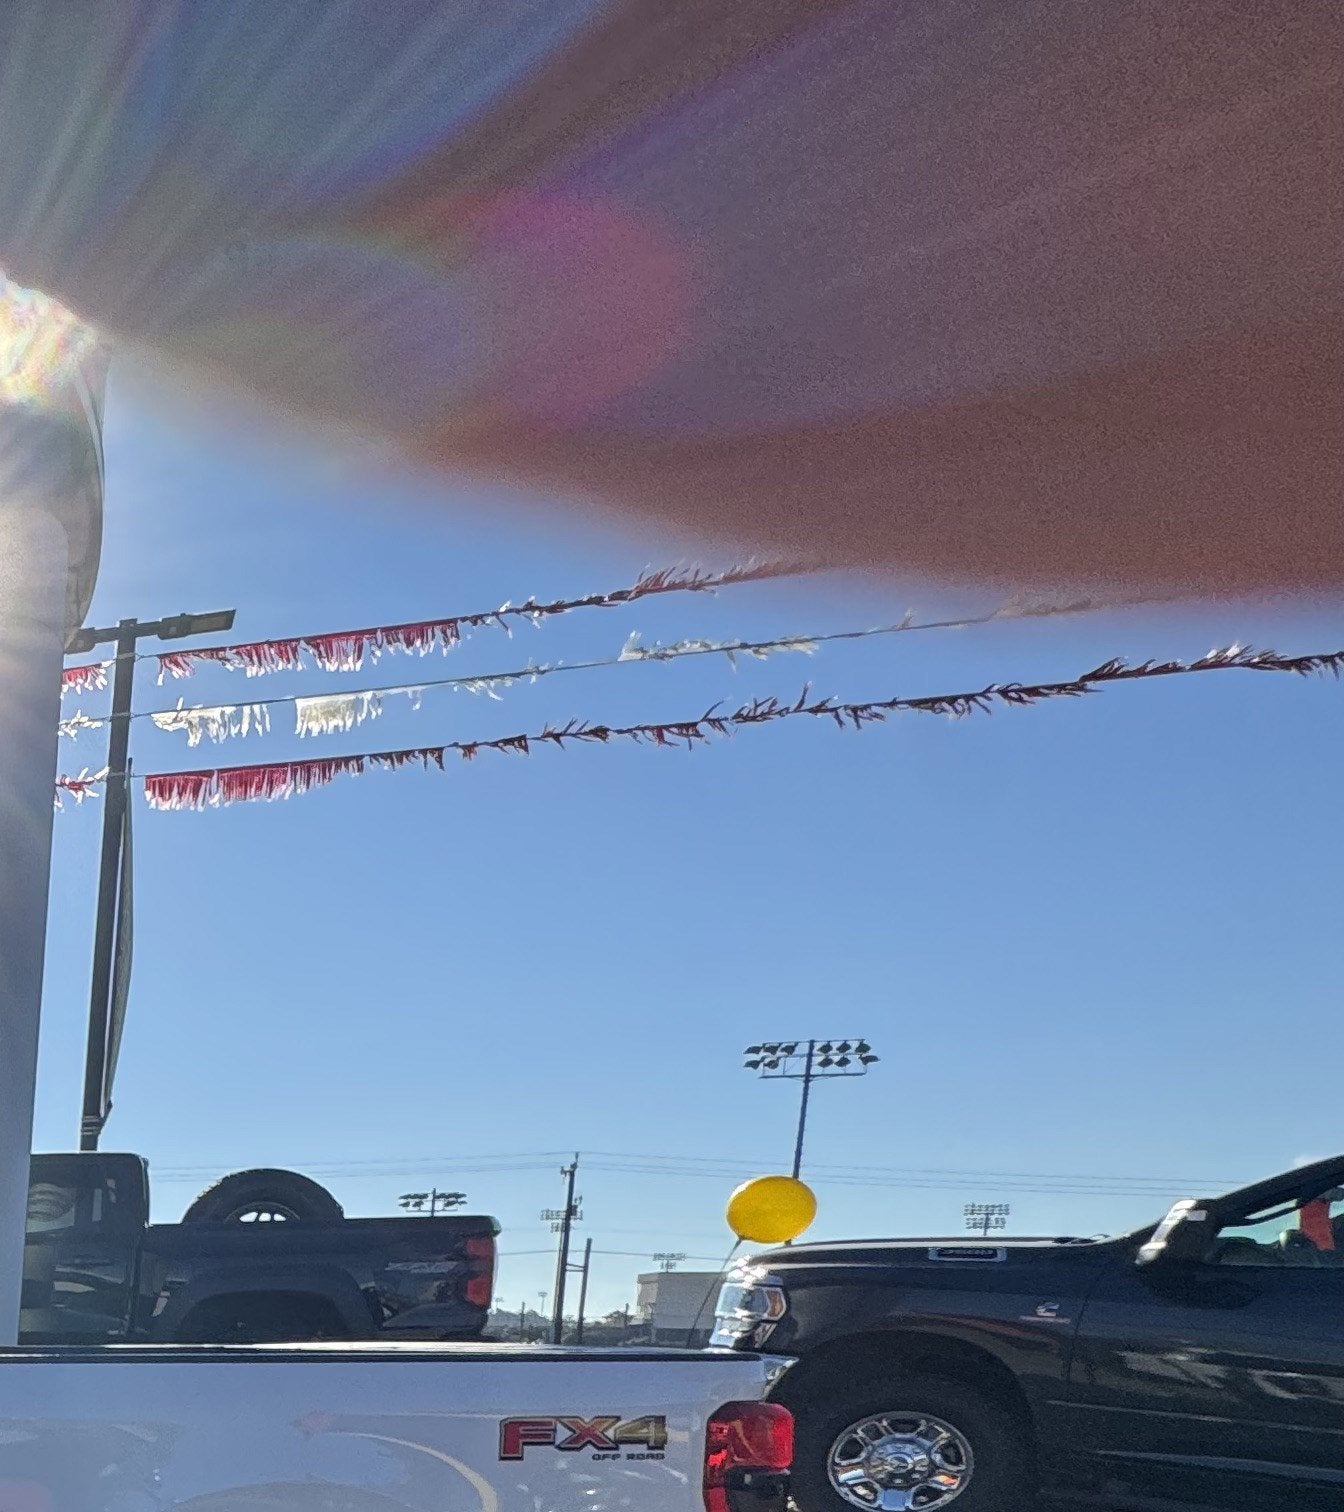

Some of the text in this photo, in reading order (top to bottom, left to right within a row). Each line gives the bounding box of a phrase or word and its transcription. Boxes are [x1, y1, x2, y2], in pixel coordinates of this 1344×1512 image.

[498, 1415, 668, 1461] FX4
[591, 1453, 665, 1461] OFF ROAD
